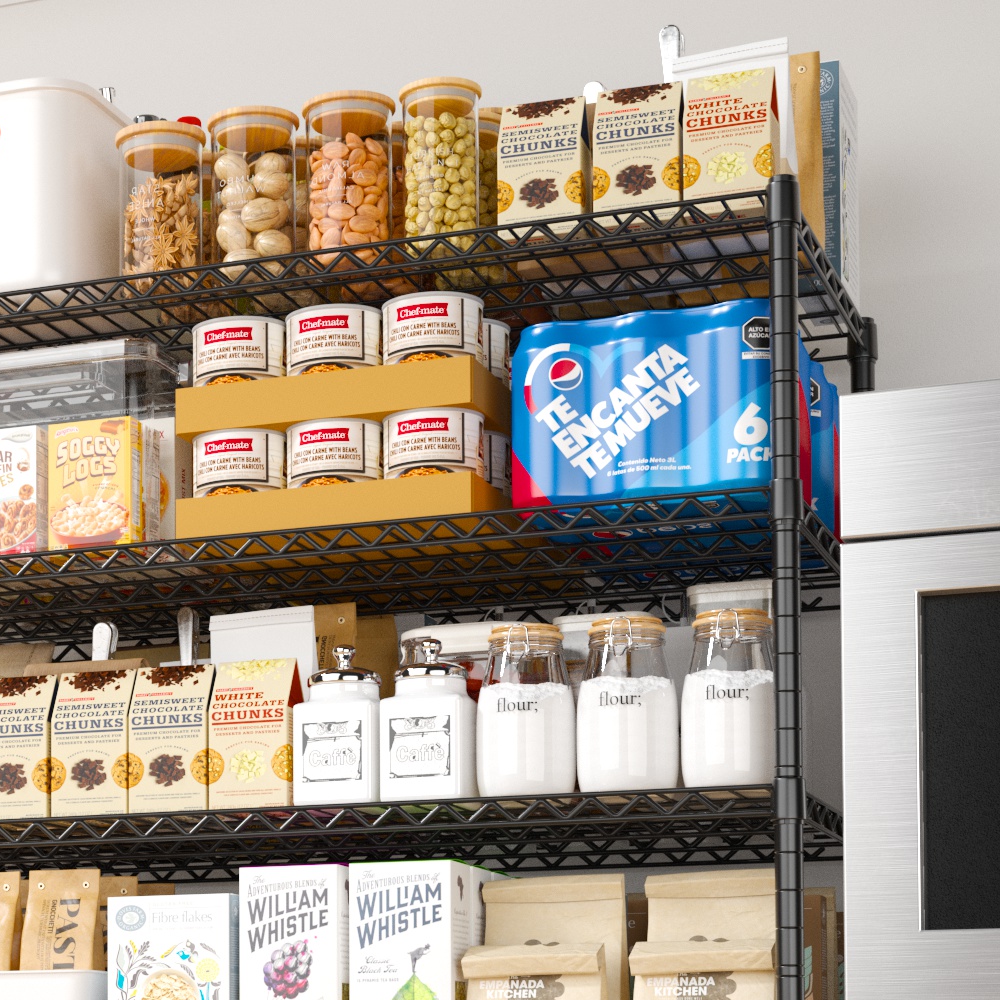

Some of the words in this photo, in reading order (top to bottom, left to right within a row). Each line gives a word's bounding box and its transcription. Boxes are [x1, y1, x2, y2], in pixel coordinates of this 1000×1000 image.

[687, 101, 767, 117] CHOCOLATE
[688, 98, 743, 110] WHITE
[597, 109, 675, 123] SEMISWEET
[597, 115, 675, 130] CHOCOLATE
[686, 108, 767, 128] CHUNKS
[501, 130, 577, 144] CHOCOLATE
[502, 123, 578, 137] SEMISWEET
[596, 122, 674, 140] CHUNKS
[501, 137, 577, 154] CHUNKS
[400, 306, 444, 318] Chef-mate
[302, 318, 345, 330] Chef-mate
[207, 330, 248, 341] Chef-mate
[552, 343, 688, 459] ENCANTA
[535, 394, 579, 433] TE
[400, 421, 445, 432] Chef-mate
[733, 402, 768, 445] 6
[302, 431, 345, 442] Chef-mate
[56, 436, 120, 468] SOGGY
[207, 441, 249, 452] Chef-mate
[618, 458, 648, 467] Contenido
[63, 456, 117, 489] LOGS
[214, 692, 264, 701] WHITE
[599, 691, 642, 707] flour;
[705, 684, 749, 700] flour;
[56, 702, 126, 711] SEMISWEET
[134, 697, 205, 706] SEMISWEET
[212, 700, 284, 710] CHOCOLATE
[496, 698, 538, 713] flour;
[55, 710, 124, 719] CHOCOLATE
[132, 704, 204, 714] CHOCOLATE
[211, 708, 284, 722] CHUNKS
[54, 718, 123, 731] CHUNKS
[131, 713, 202, 726] CHUNKS
[308, 747, 356, 767] Caffè
[395, 742, 445, 763] Caffè
[295, 879, 317, 888] BLENDS
[406, 873, 430, 883] BLENDS
[247, 888, 328, 925] WILLIAM
[356, 882, 442, 921] WILLIAM
[152, 911, 179, 924] Fibre
[181, 909, 213, 924] flakes
[248, 909, 329, 953] WHISTLE
[356, 904, 442, 949] WHISTLE
[52, 898, 81, 970] PAST
[479, 979, 545, 990] EMPANADA
[647, 978, 715, 987] EMPANADA
[487, 988, 537, 999] KITCHEN
[654, 986, 708, 996] KITCHEN
